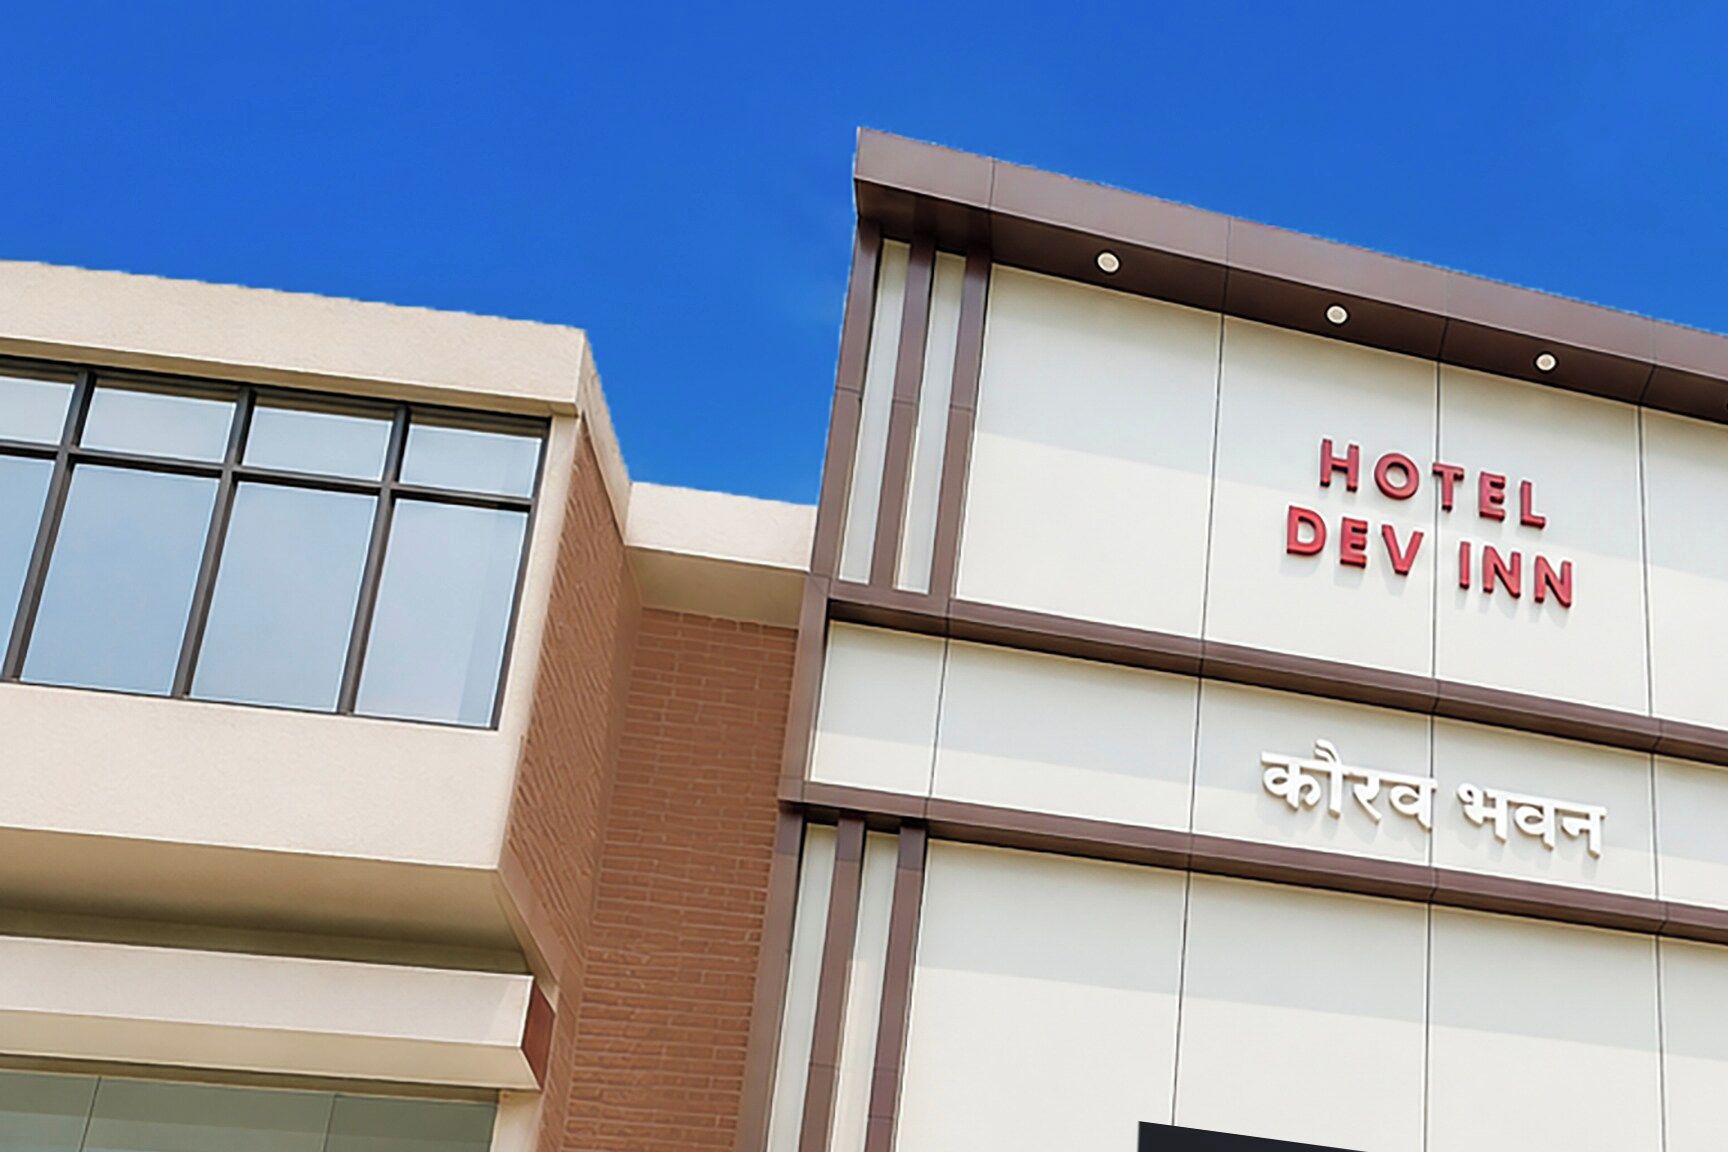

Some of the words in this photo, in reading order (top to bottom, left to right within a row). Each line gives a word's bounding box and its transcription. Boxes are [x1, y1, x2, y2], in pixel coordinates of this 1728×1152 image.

[1319, 438, 1546, 529] HOTEL
[1286, 505, 1424, 575] DEV
[1458, 541, 1572, 607] INN
[1261, 739, 1437, 829] कौरव
[1457, 782, 1607, 858] भवन
